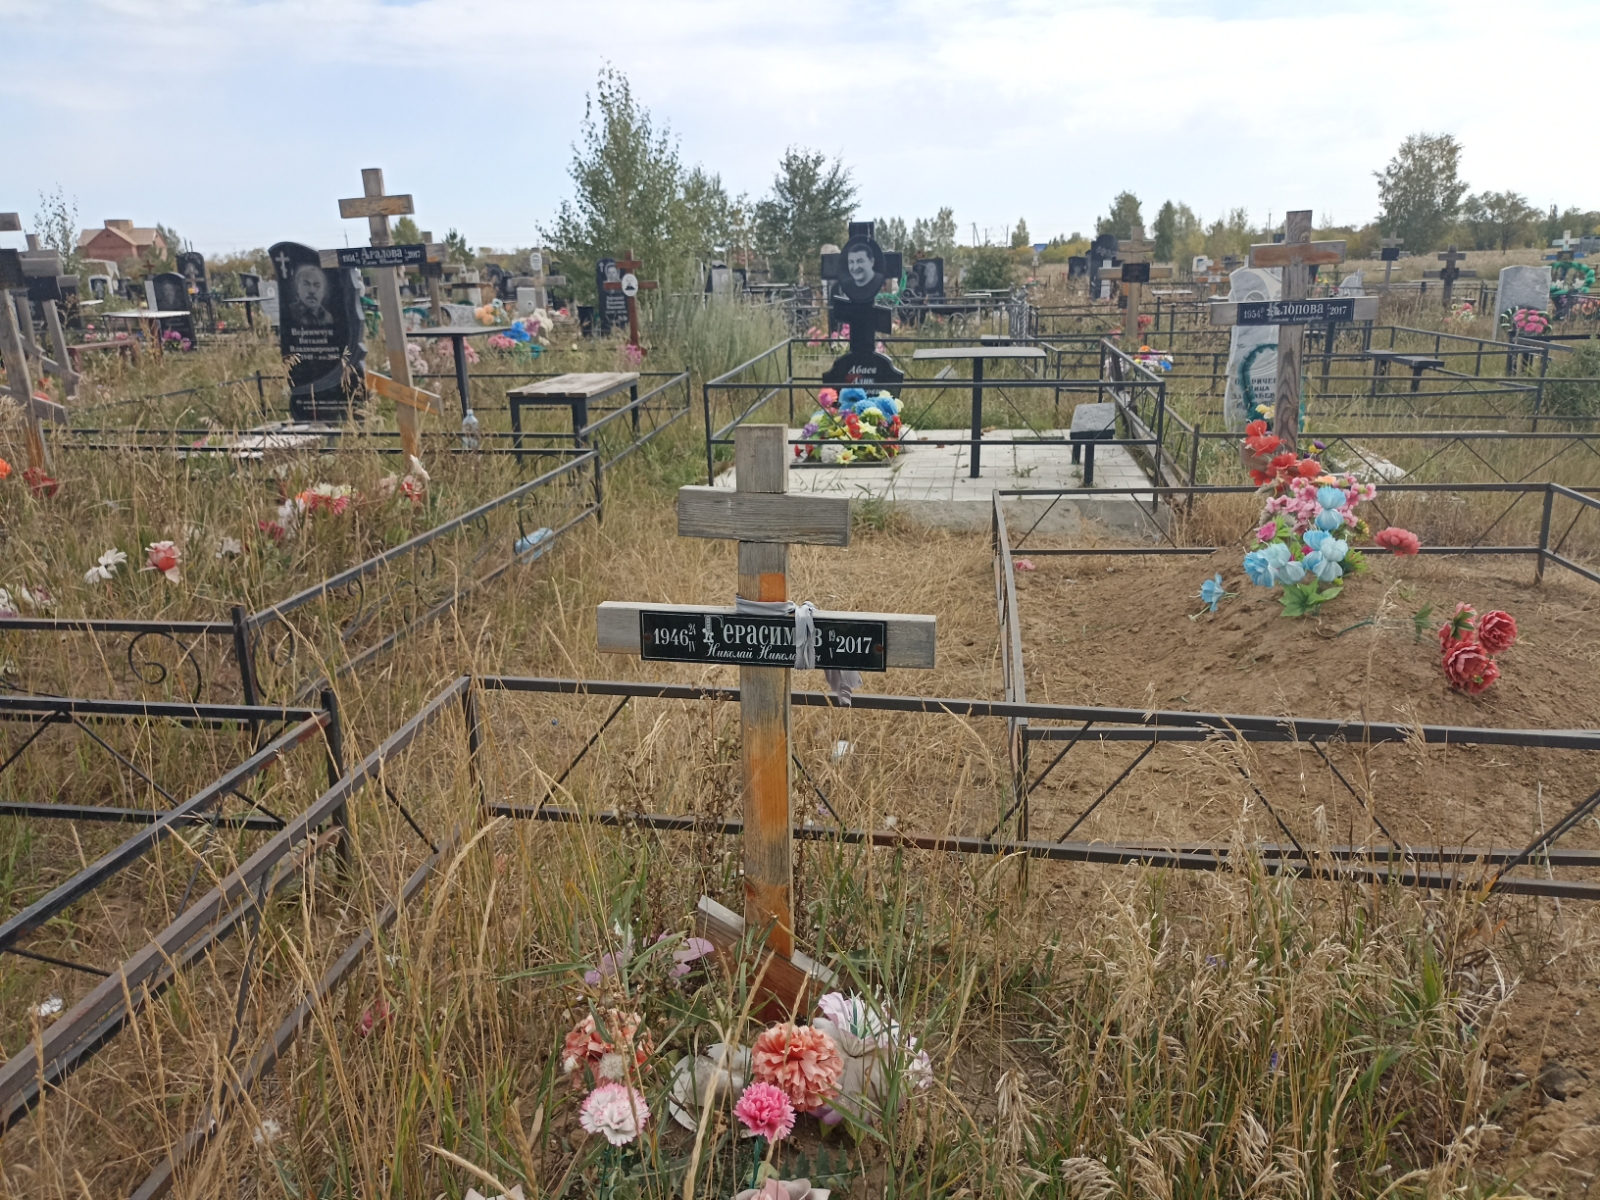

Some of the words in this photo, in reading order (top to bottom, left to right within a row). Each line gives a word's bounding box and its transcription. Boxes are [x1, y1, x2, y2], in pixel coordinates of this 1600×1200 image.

[1329, 305, 1348, 316] 2017
[848, 365, 877, 375] Абаев
[653, 627, 689, 646] 1946
[702, 614, 823, 647] Герасимв
[835, 635, 873, 654] 2017
[706, 642, 754, 659] Николай
